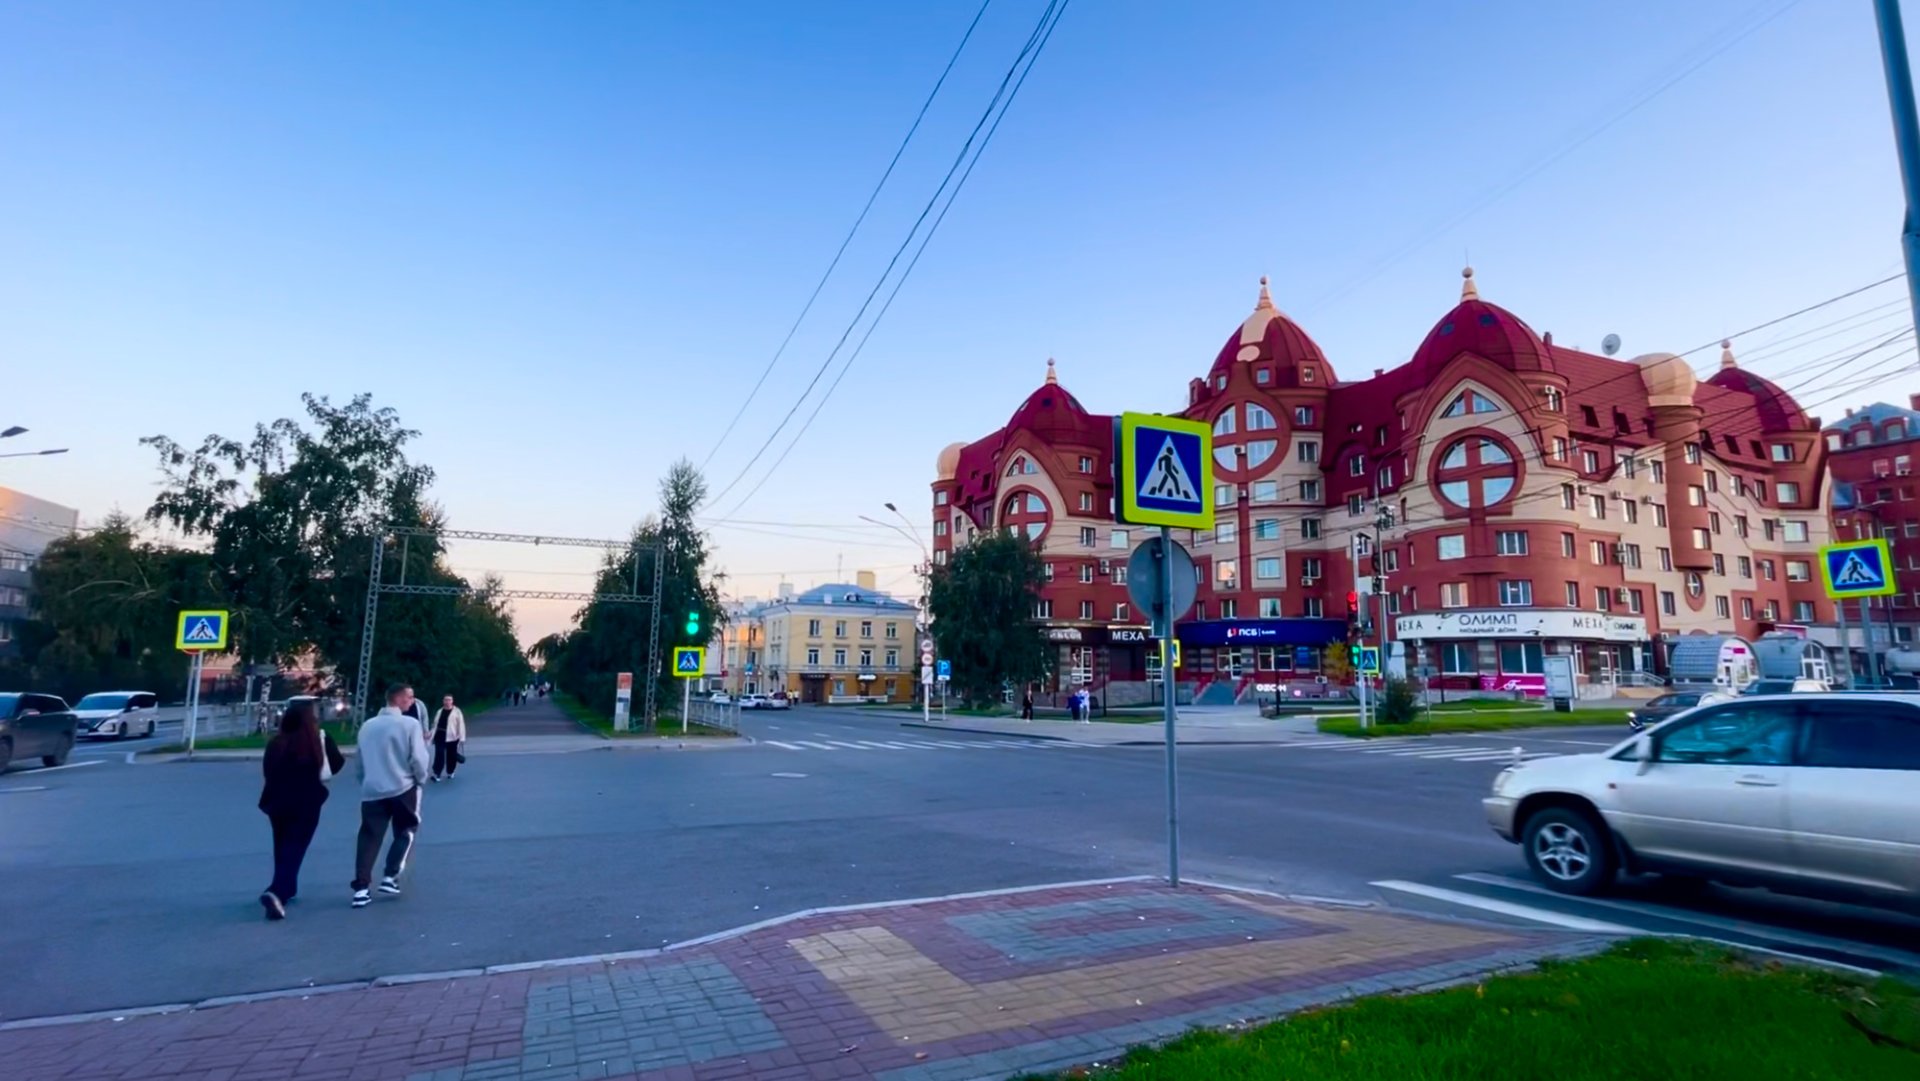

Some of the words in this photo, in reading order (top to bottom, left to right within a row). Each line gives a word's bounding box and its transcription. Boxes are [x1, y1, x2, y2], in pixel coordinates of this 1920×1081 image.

[1459, 613, 1518, 626] ОЛИМП
[1112, 631, 1145, 641] МЕХА
[1238, 628, 1258, 636] ПСБ
